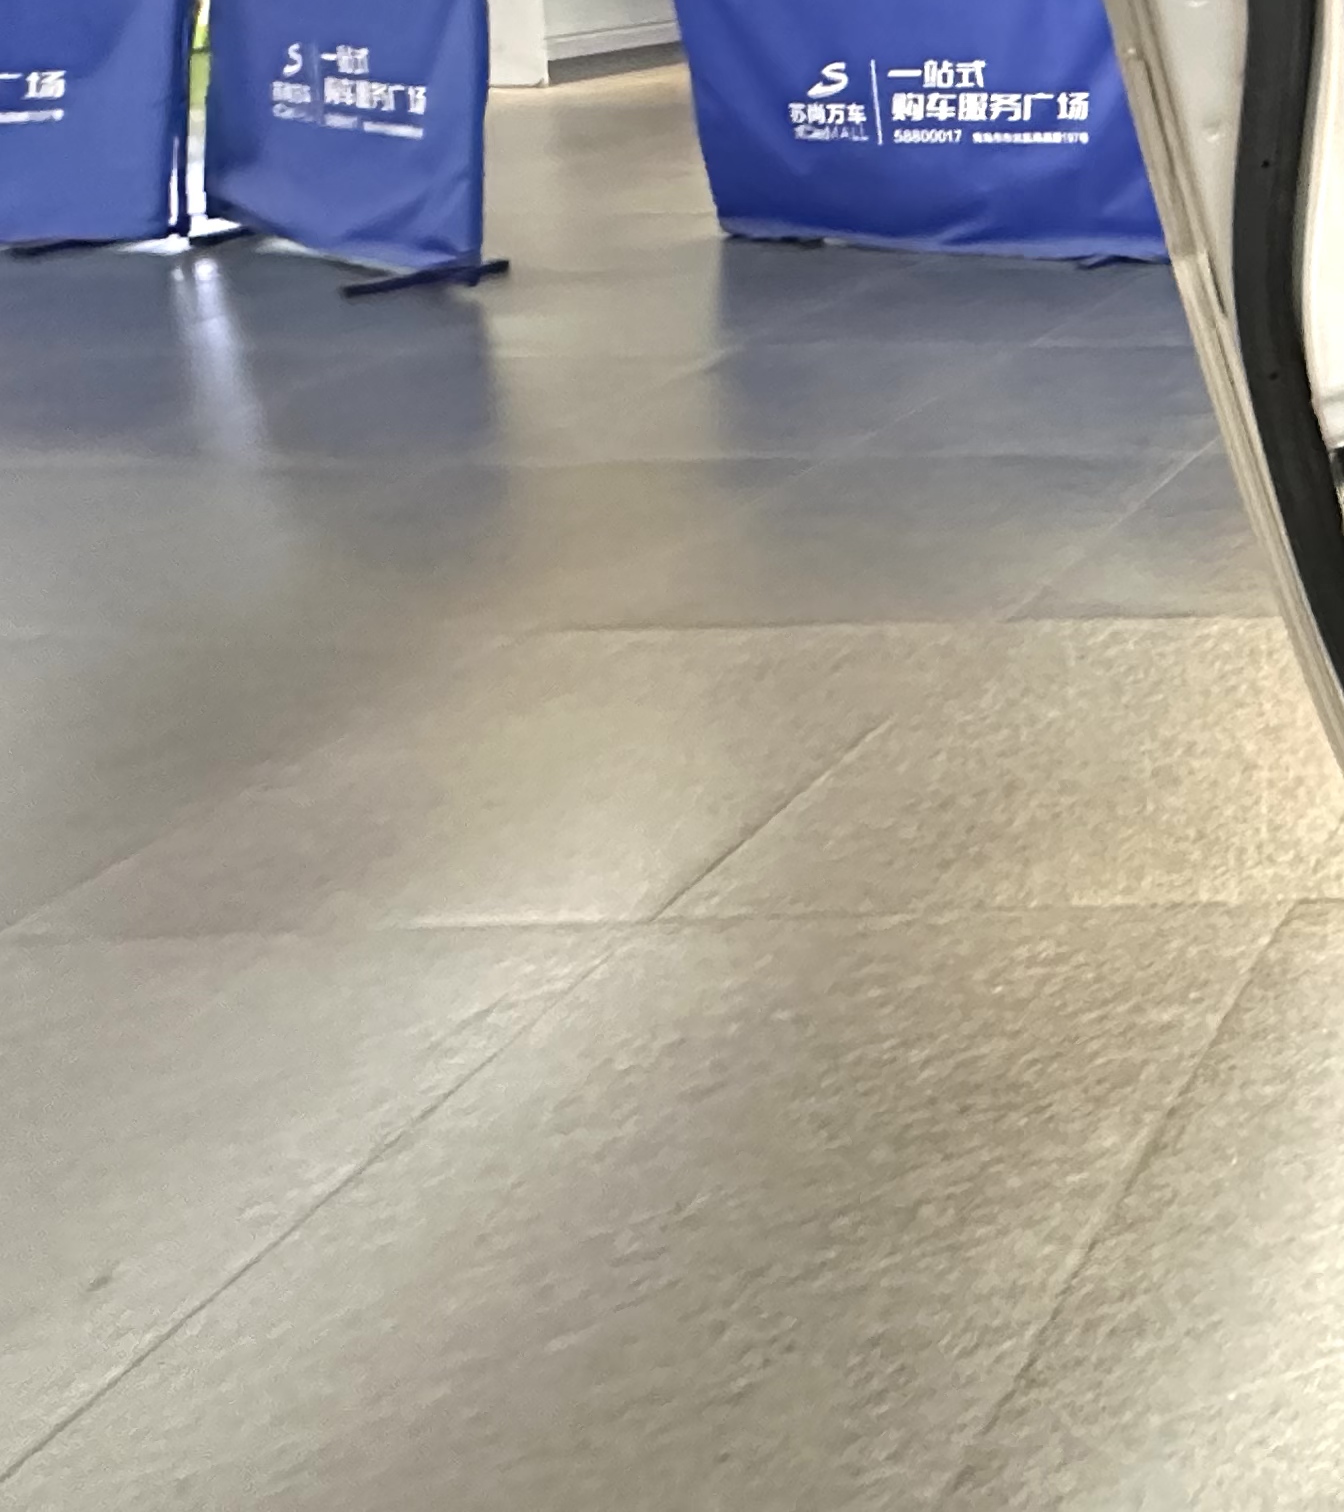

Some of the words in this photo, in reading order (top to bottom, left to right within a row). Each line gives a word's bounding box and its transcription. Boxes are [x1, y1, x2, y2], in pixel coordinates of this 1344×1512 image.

[887, 59, 987, 89] 一站式
[788, 101, 867, 125] 苏尚万车
[890, 91, 1090, 123] 购车服务广场
